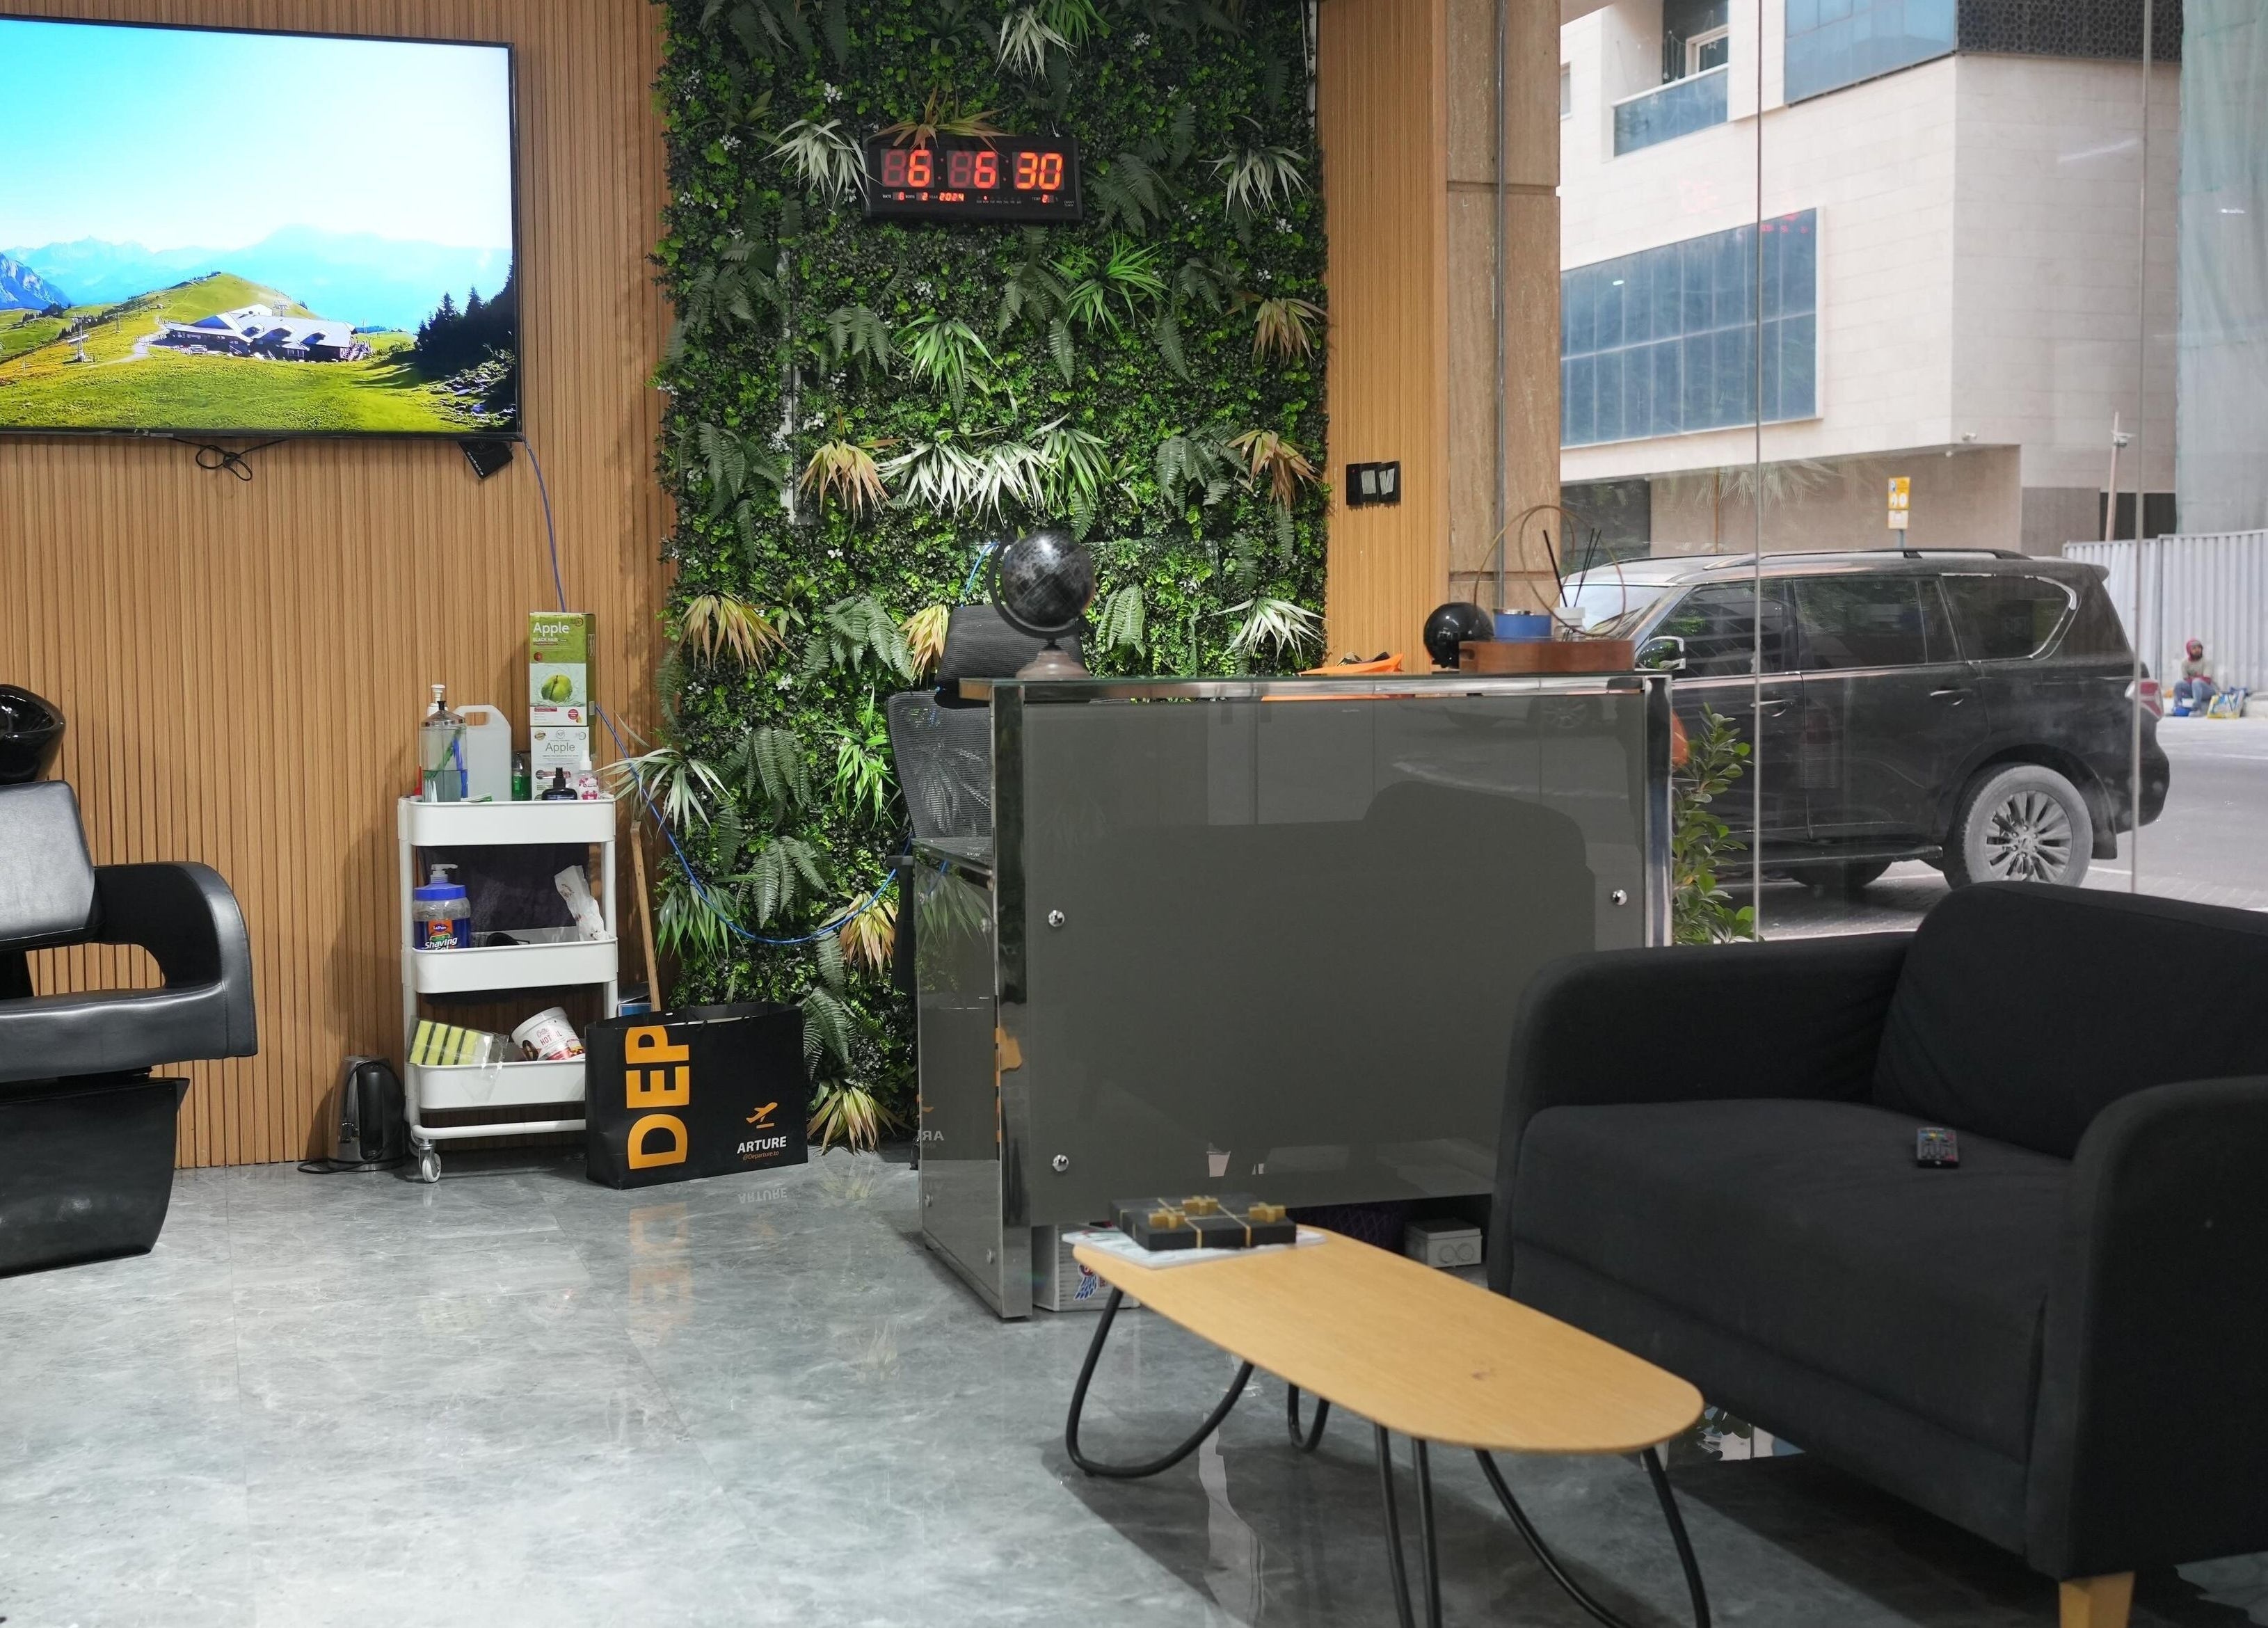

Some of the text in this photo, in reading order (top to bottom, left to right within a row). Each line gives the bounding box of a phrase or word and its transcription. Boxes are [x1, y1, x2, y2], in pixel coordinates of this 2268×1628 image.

[1016, 152, 1063, 190] 30
[533, 621, 570, 637] Apple
[545, 742, 575, 753] Apple
[424, 937, 458, 950] Shaving
[540, 1035, 552, 1046] HOT
[625, 1025, 689, 1169] DEP
[737, 1135, 787, 1154] ARTURE
[742, 1150, 779, 1161] @Departure.to
